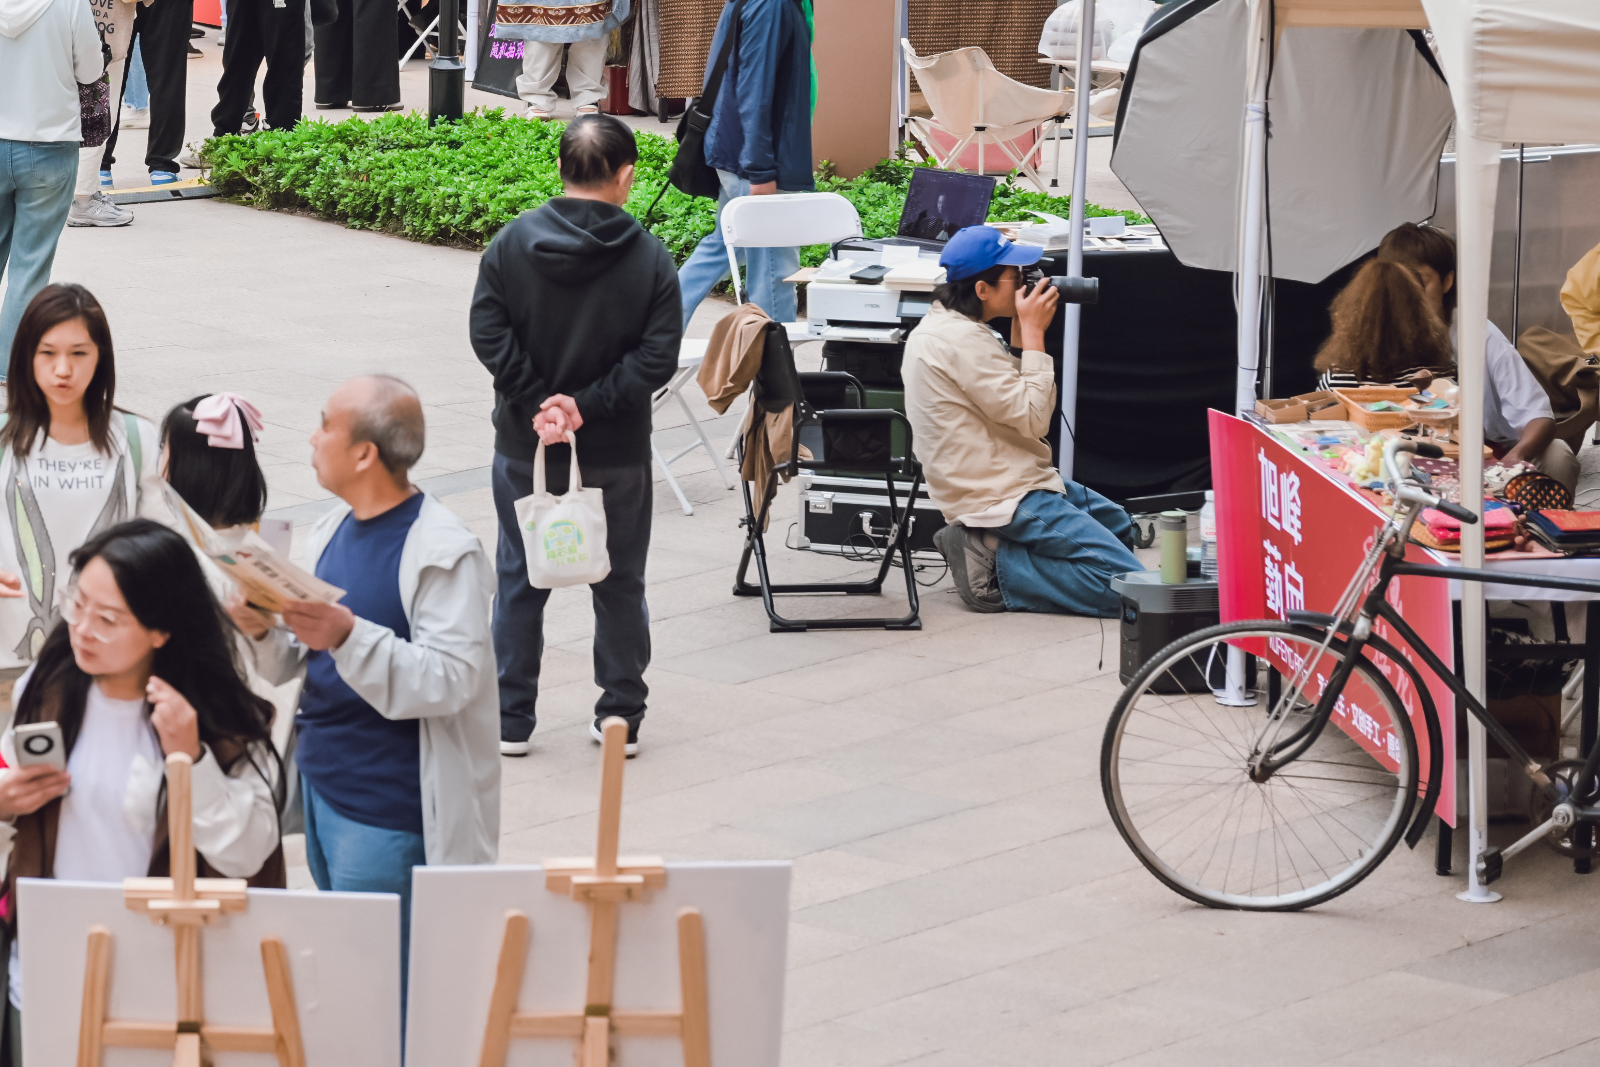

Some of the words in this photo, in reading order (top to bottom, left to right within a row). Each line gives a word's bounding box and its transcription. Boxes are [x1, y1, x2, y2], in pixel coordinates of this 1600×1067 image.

[92, 8, 101, 17] ND
[102, 11, 109, 20] A
[37, 458, 103, 473] THEY'RE
[33, 475, 50, 489] IN
[57, 475, 105, 490] WHIT
